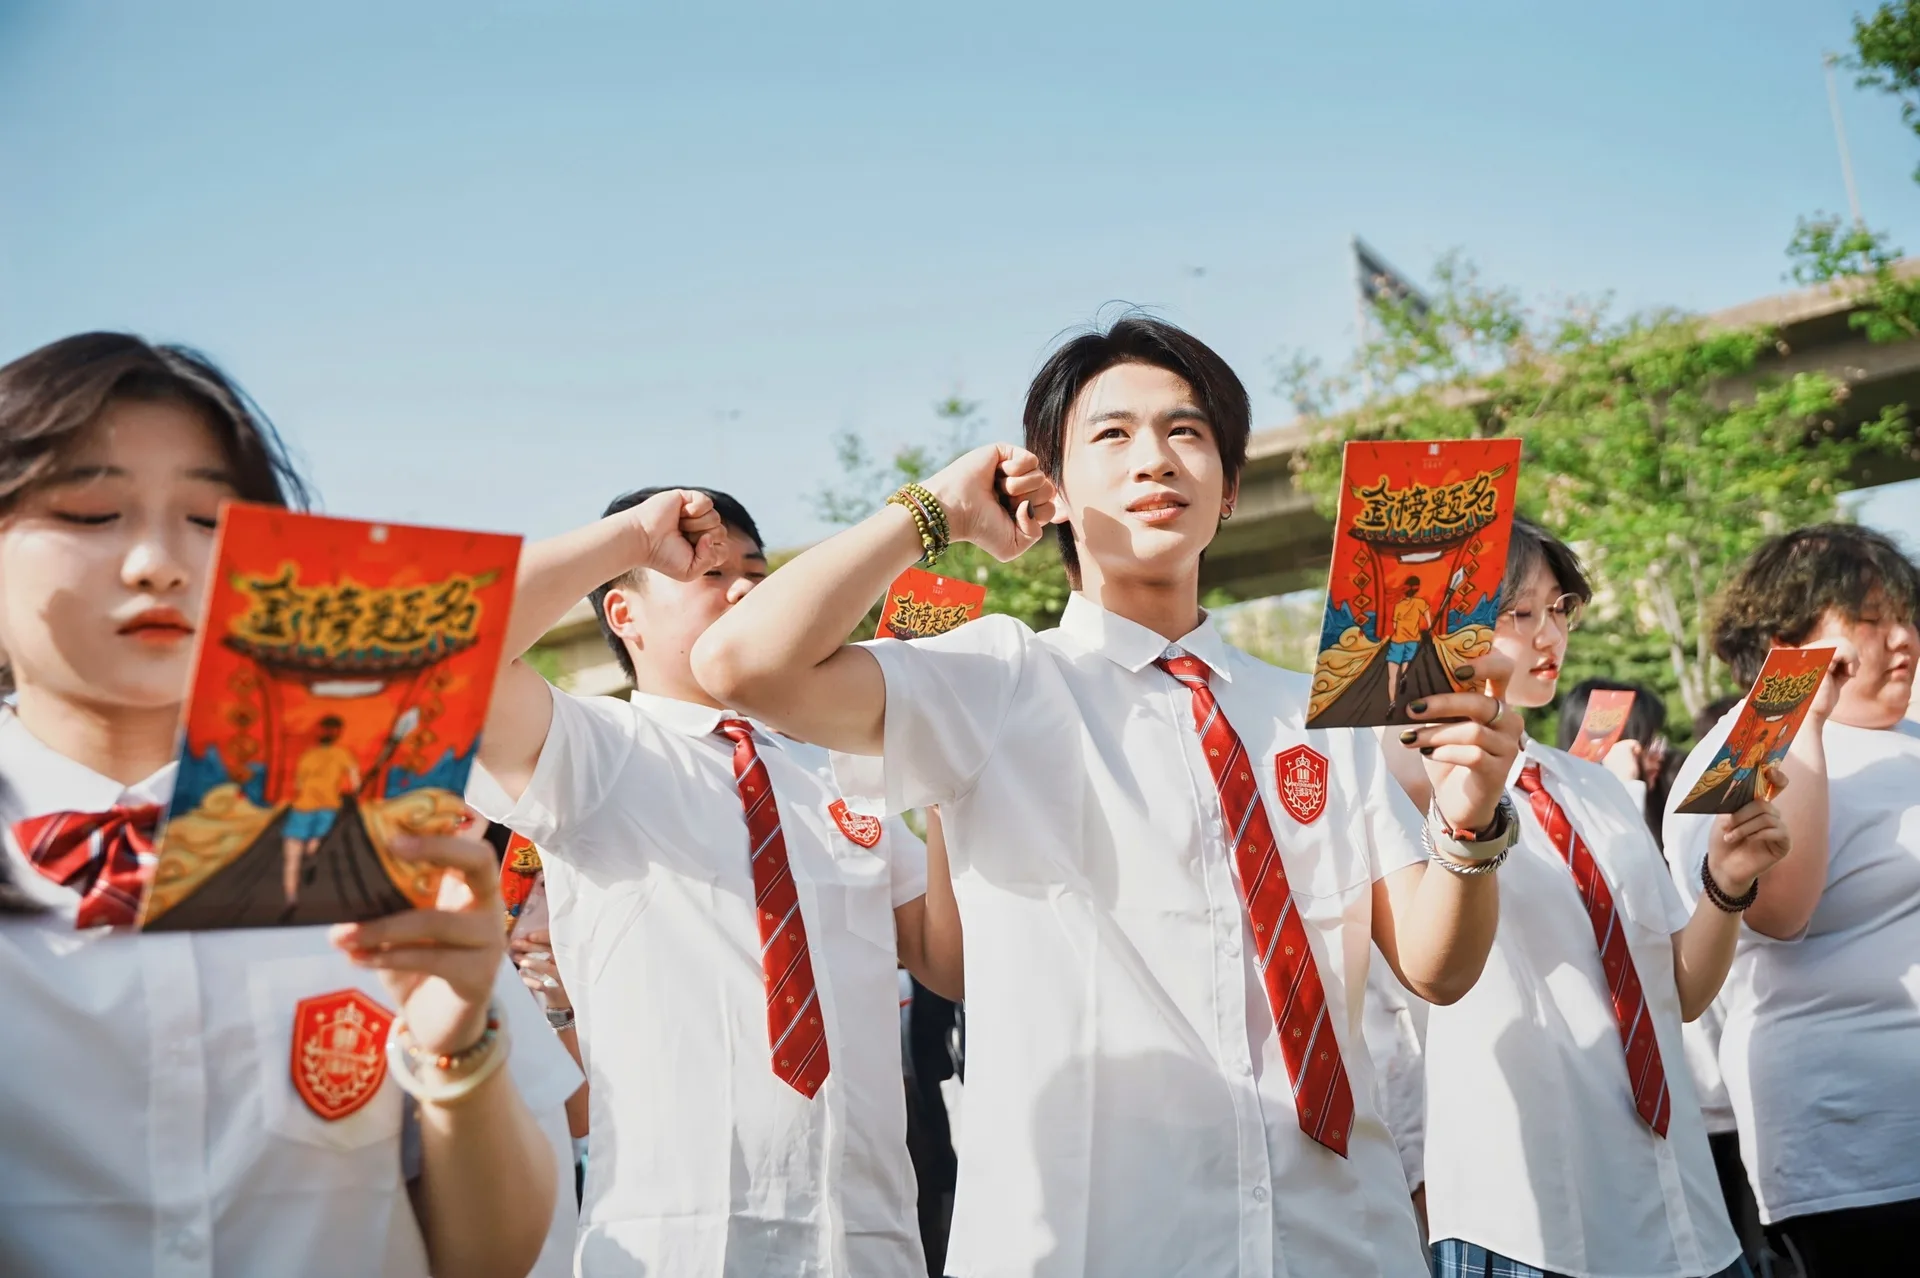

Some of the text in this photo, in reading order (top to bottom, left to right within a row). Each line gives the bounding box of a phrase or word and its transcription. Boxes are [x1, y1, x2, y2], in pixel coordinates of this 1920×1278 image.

[1355, 475, 1497, 531] 金榜题名
[244, 563, 480, 647] 金榜题名
[1757, 669, 1818, 703] 金榜题名
